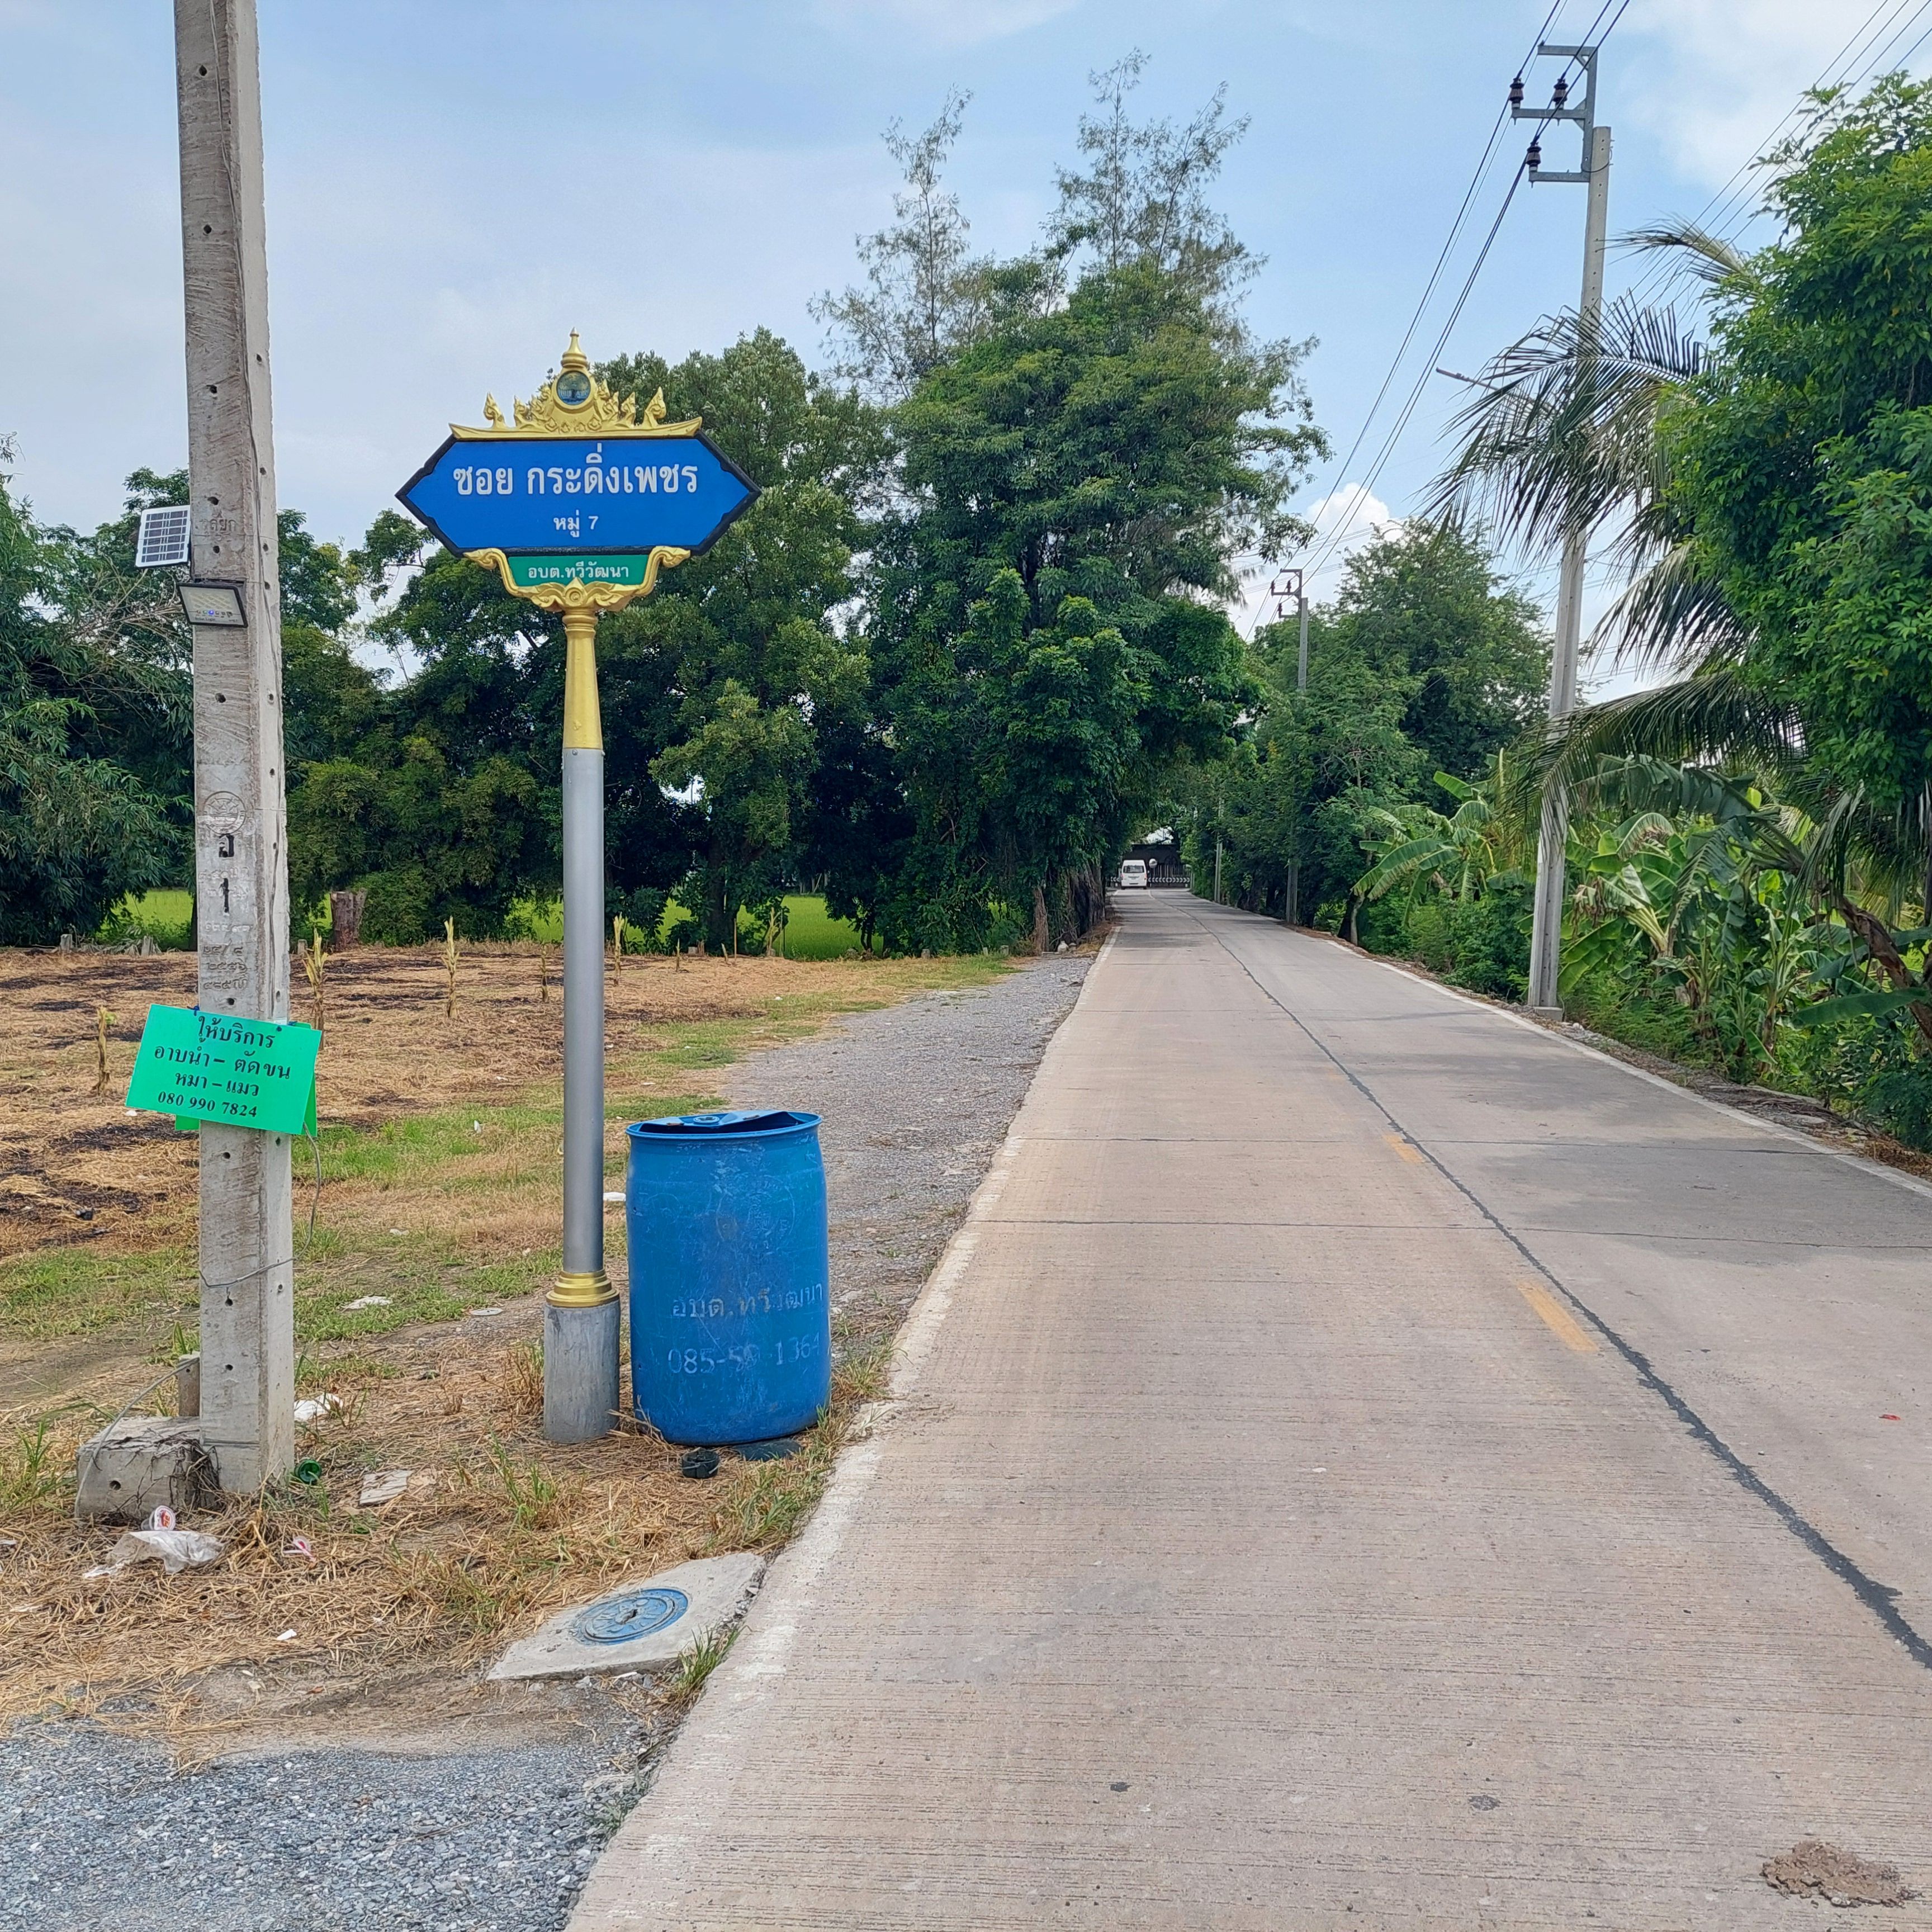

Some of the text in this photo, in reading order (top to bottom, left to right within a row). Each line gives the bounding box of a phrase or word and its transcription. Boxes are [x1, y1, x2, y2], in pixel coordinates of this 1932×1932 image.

[453, 442, 699, 495] ซอย กระดิ่งเพชร
[553, 509, 599, 538] หมู่ 7
[528, 561, 629, 579] อบต.ทวีวัฒนา
[198, 1015, 276, 1048] ให้บริการ
[234, 1050, 291, 1079] ตัดขน
[157, 1091, 258, 1117] 080 990 7824
